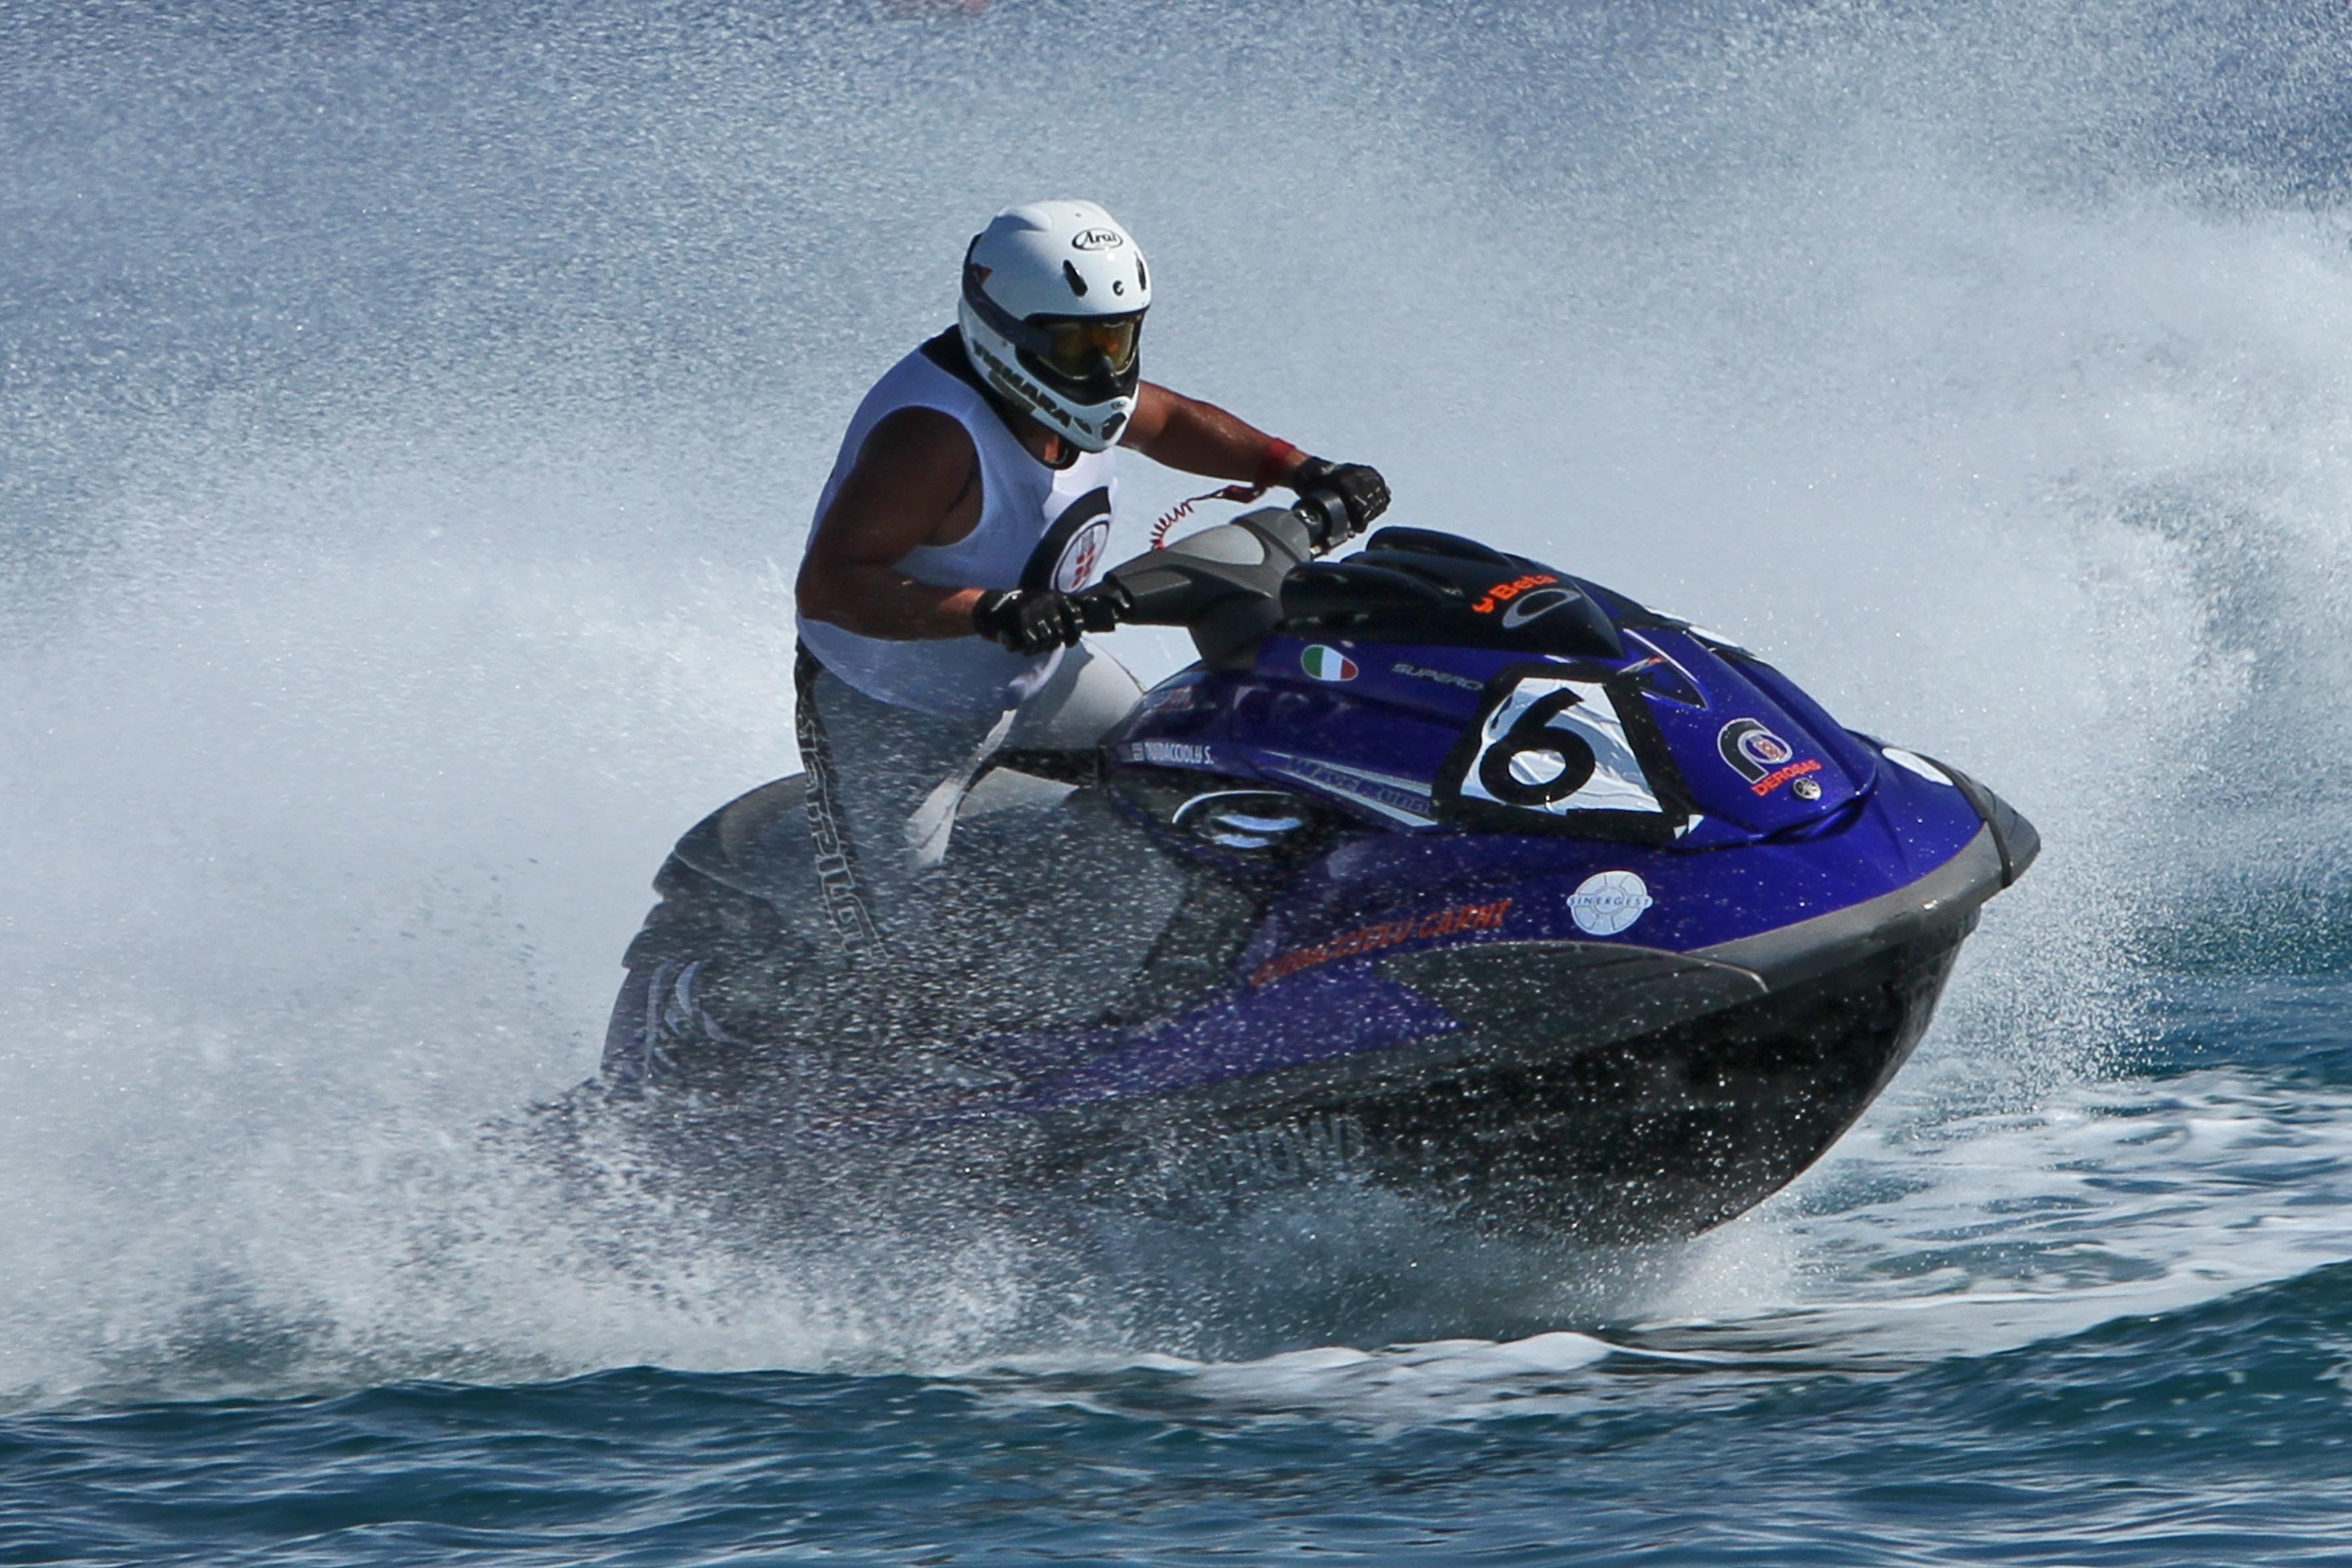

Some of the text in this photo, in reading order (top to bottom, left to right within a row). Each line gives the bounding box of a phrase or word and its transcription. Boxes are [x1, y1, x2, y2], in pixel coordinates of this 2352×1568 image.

[1079, 229, 1118, 248] Arai
[1489, 574, 1558, 601] Beta
[1479, 687, 1595, 806] 6
[1418, 900, 1513, 938] CARNI
